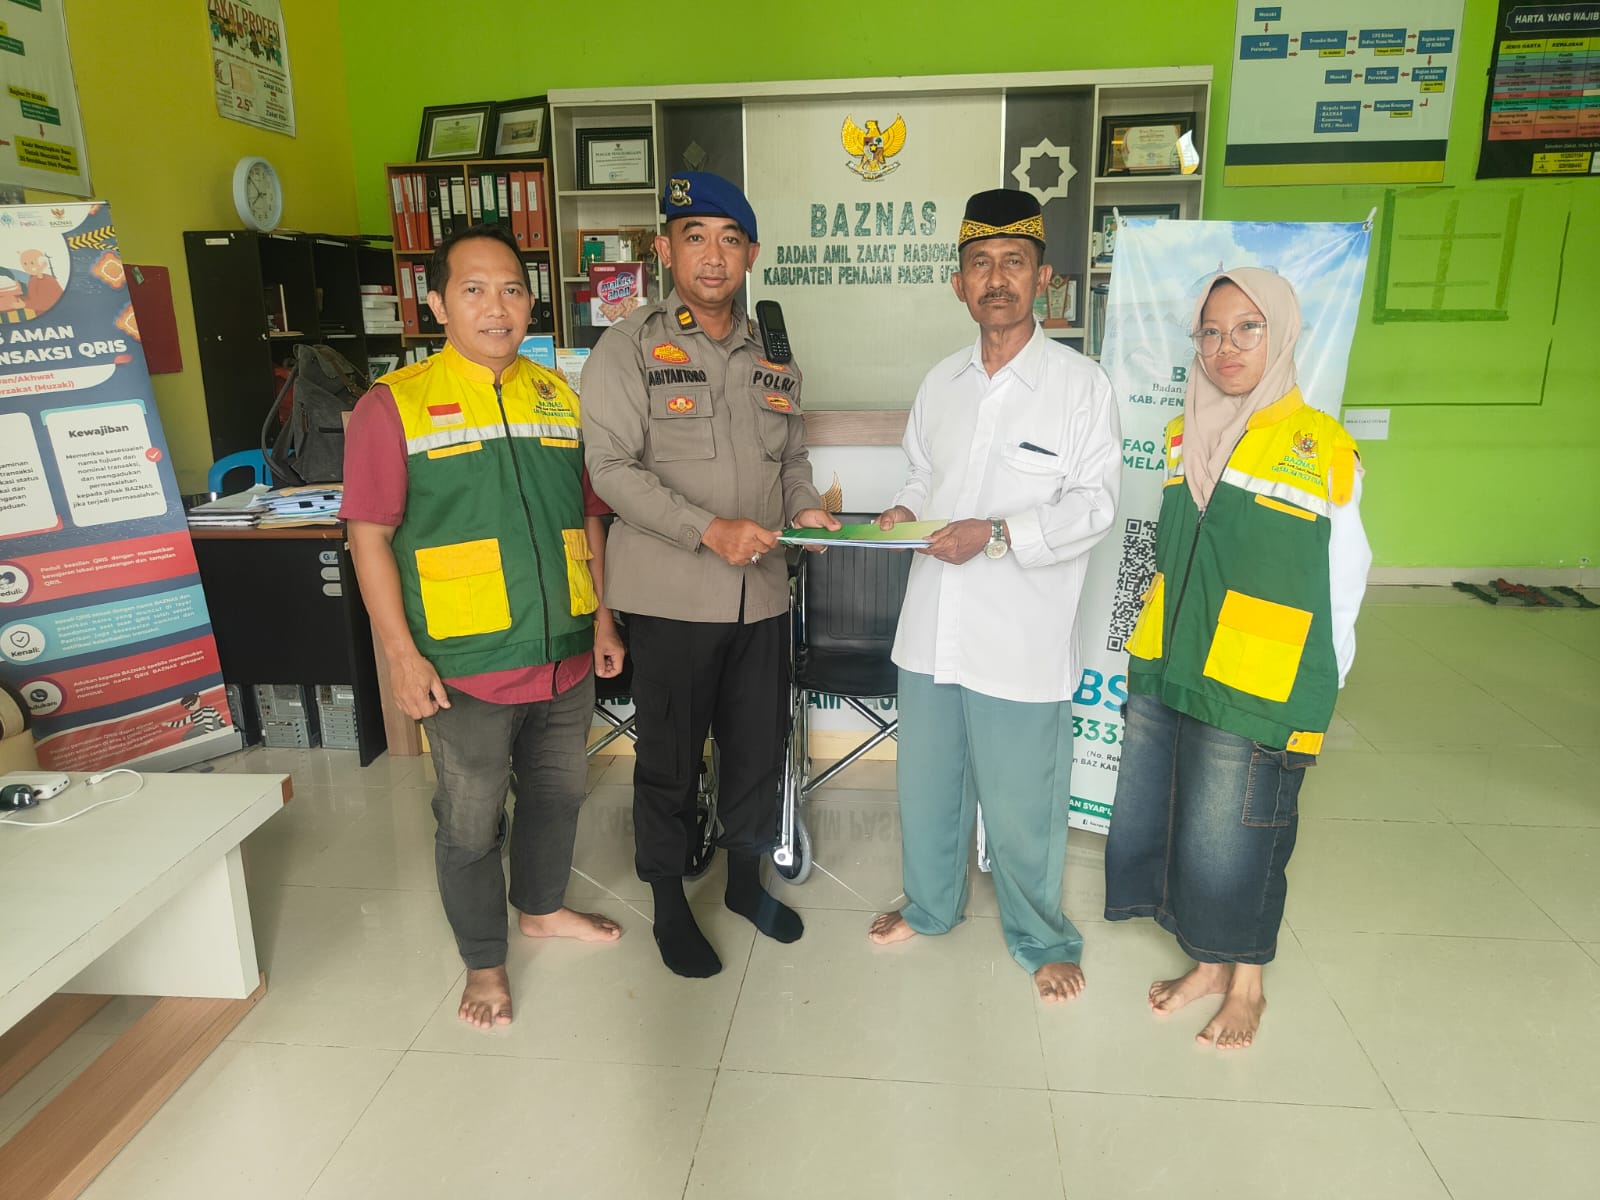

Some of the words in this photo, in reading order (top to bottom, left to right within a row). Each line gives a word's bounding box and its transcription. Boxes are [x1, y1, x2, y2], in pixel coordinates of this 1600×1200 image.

[1515, 14, 1544, 24] HARTA
[1547, 13, 1571, 22] YANG
[1573, 12, 1600, 21] WAJIB
[811, 201, 937, 238] BAZNAS
[777, 245, 817, 264] BADAN
[823, 244, 851, 264] AMIL
[857, 243, 897, 263] ZAKAT
[763, 266, 833, 286] KABUPATEN
[838, 266, 893, 285] PENAJAM
[898, 265, 934, 285] PASER
[10, 325, 74, 344] AMAN
[78, 339, 127, 358] QRIS
[649, 368, 707, 387] ABIYANTORO
[753, 370, 796, 392] POLRI
[34, 381, 75, 393] (Muzaki)
[1152, 383, 1183, 394] Badan
[1128, 394, 1156, 405] KAB.
[68, 424, 130, 439] Kewajiban
[1122, 439, 1156, 454] FAQ
[11, 647, 40, 658] Kenali:
[1087, 749, 1104, 760] (No.
[1080, 759, 1097, 768] BAZ
